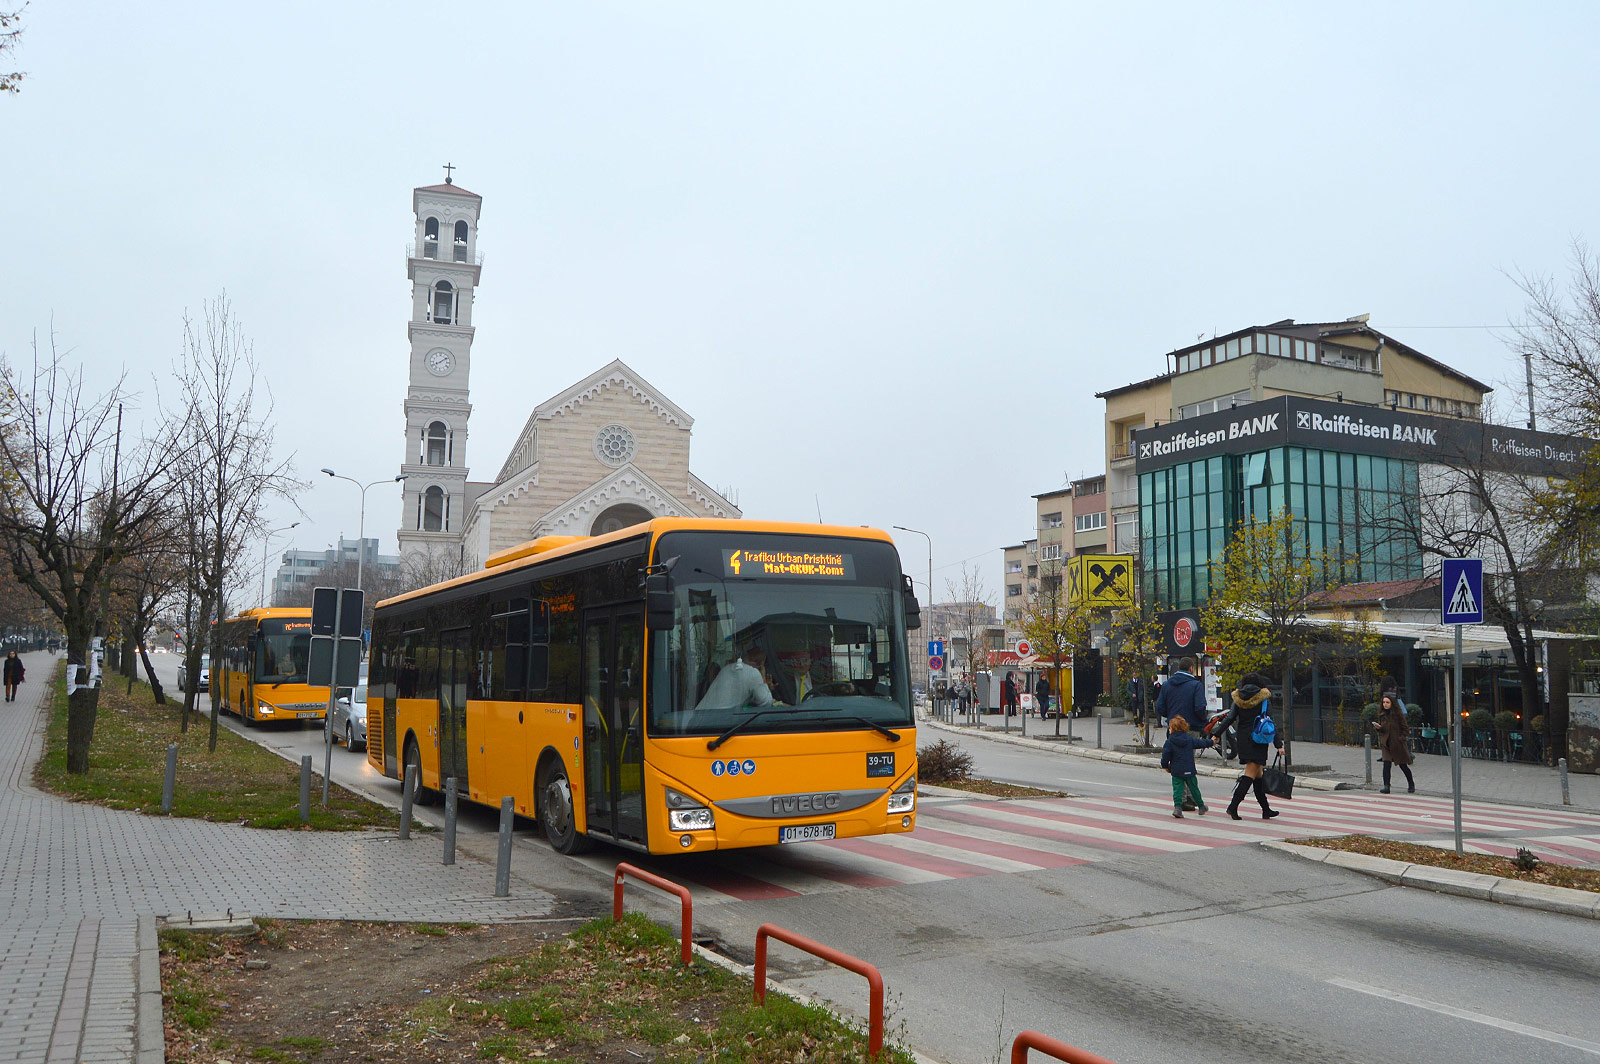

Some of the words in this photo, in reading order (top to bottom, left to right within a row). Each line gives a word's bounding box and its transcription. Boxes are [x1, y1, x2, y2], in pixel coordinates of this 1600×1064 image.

[1153, 429, 1226, 456] Raiffeisen
[1228, 412, 1280, 440] BANK
[1312, 413, 1390, 439] Raiffeisen
[1392, 423, 1438, 446] BANK
[1491, 438, 1542, 459] Raiffeisen
[730, 549, 741, 575] 4
[744, 551, 776, 563] Trafiku
[776, 552, 803, 564] Urban
[868, 755, 893, 766] 39-TU
[772, 792, 841, 814] IVECO
